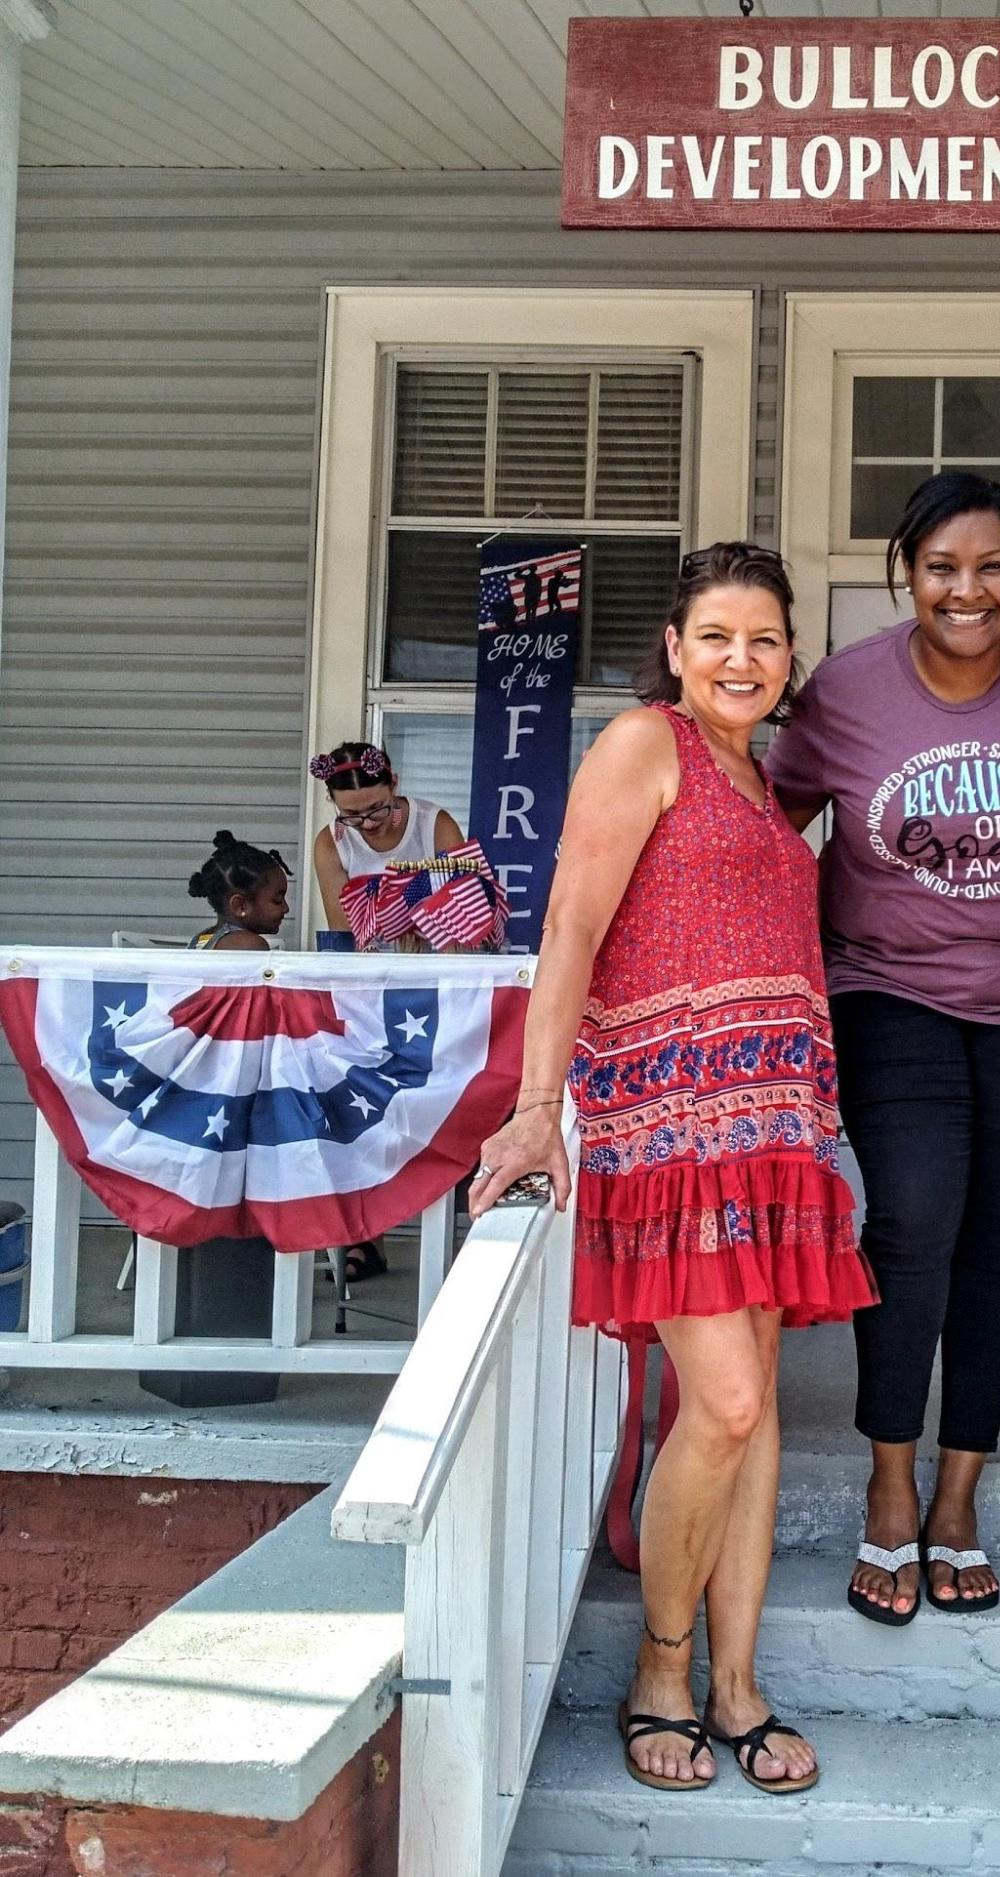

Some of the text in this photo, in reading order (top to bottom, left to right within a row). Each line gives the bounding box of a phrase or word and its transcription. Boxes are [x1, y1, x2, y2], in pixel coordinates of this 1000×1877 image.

[487, 633, 569, 661] HOME
[500, 662, 552, 698] of the
[903, 741, 981, 777] STRONGER
[866, 771, 905, 830] INSPIRED
[914, 866, 960, 898] FOUND
[946, 858, 954, 880] I
